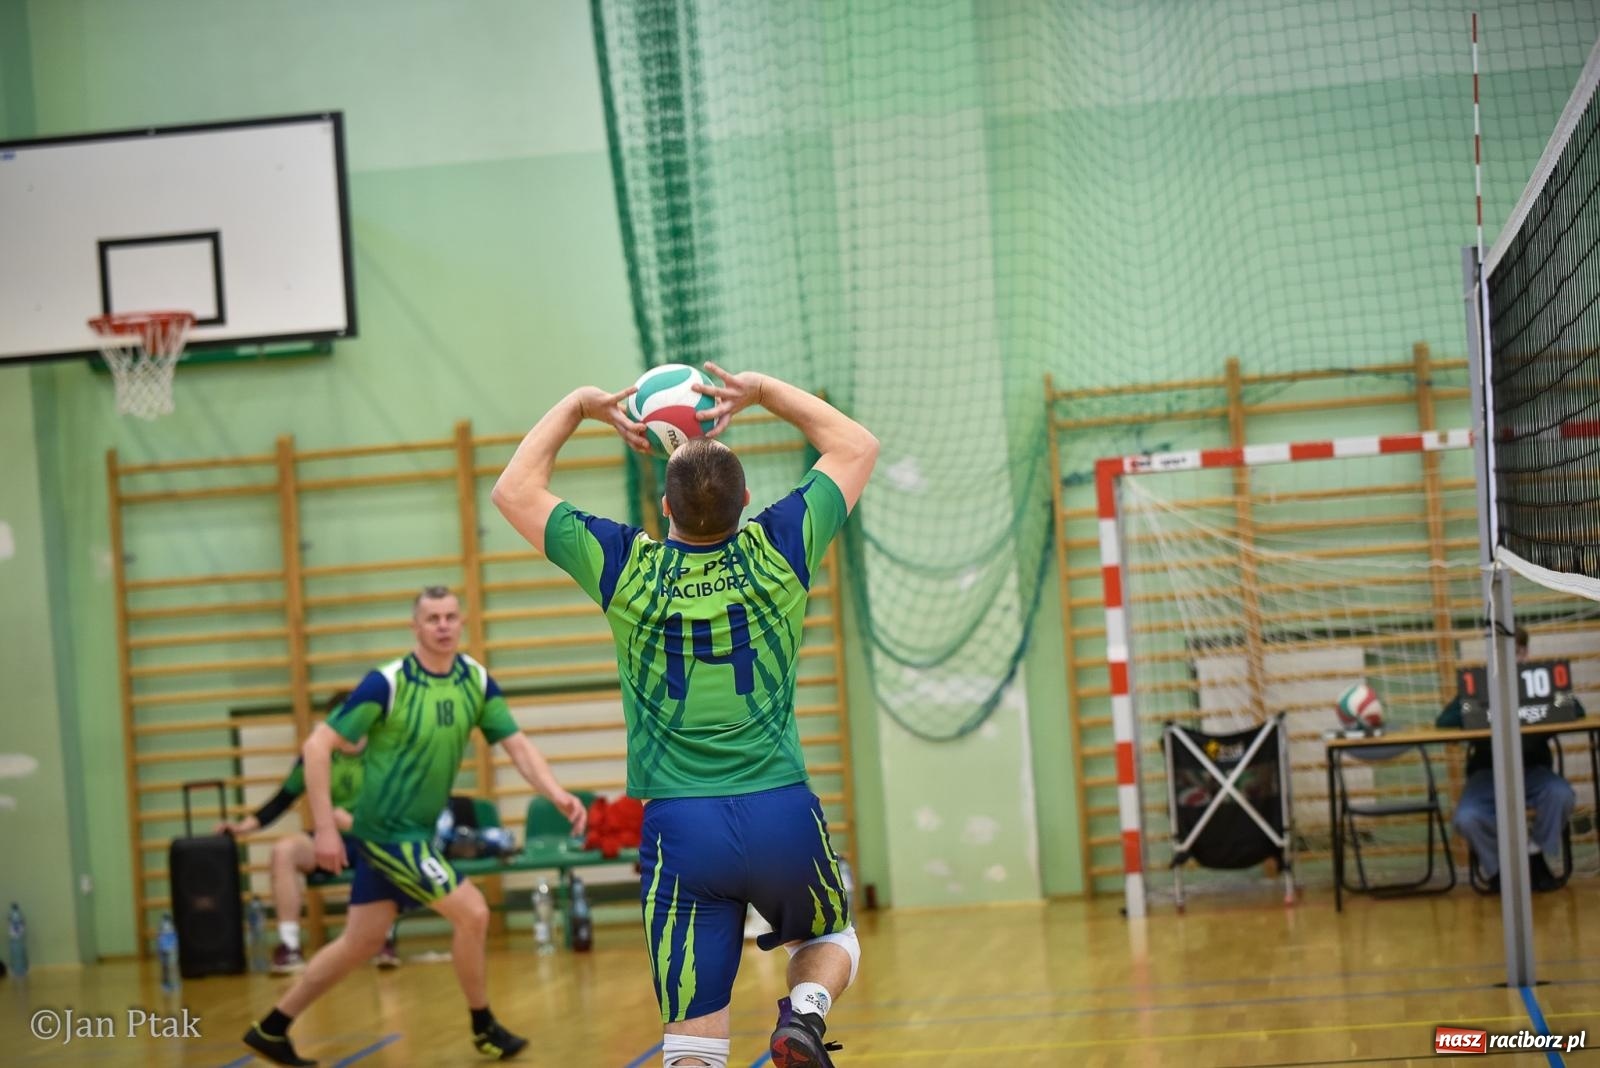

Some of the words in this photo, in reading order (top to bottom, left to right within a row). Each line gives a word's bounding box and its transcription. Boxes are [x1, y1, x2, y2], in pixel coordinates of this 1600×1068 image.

[661, 567, 690, 581] KP
[661, 574, 749, 599] RACIBÓRZ
[664, 602, 758, 700] 14
[1463, 671, 1476, 697] 1
[1521, 667, 1550, 698] 10
[1552, 663, 1569, 689] 0
[436, 699, 455, 728] 18
